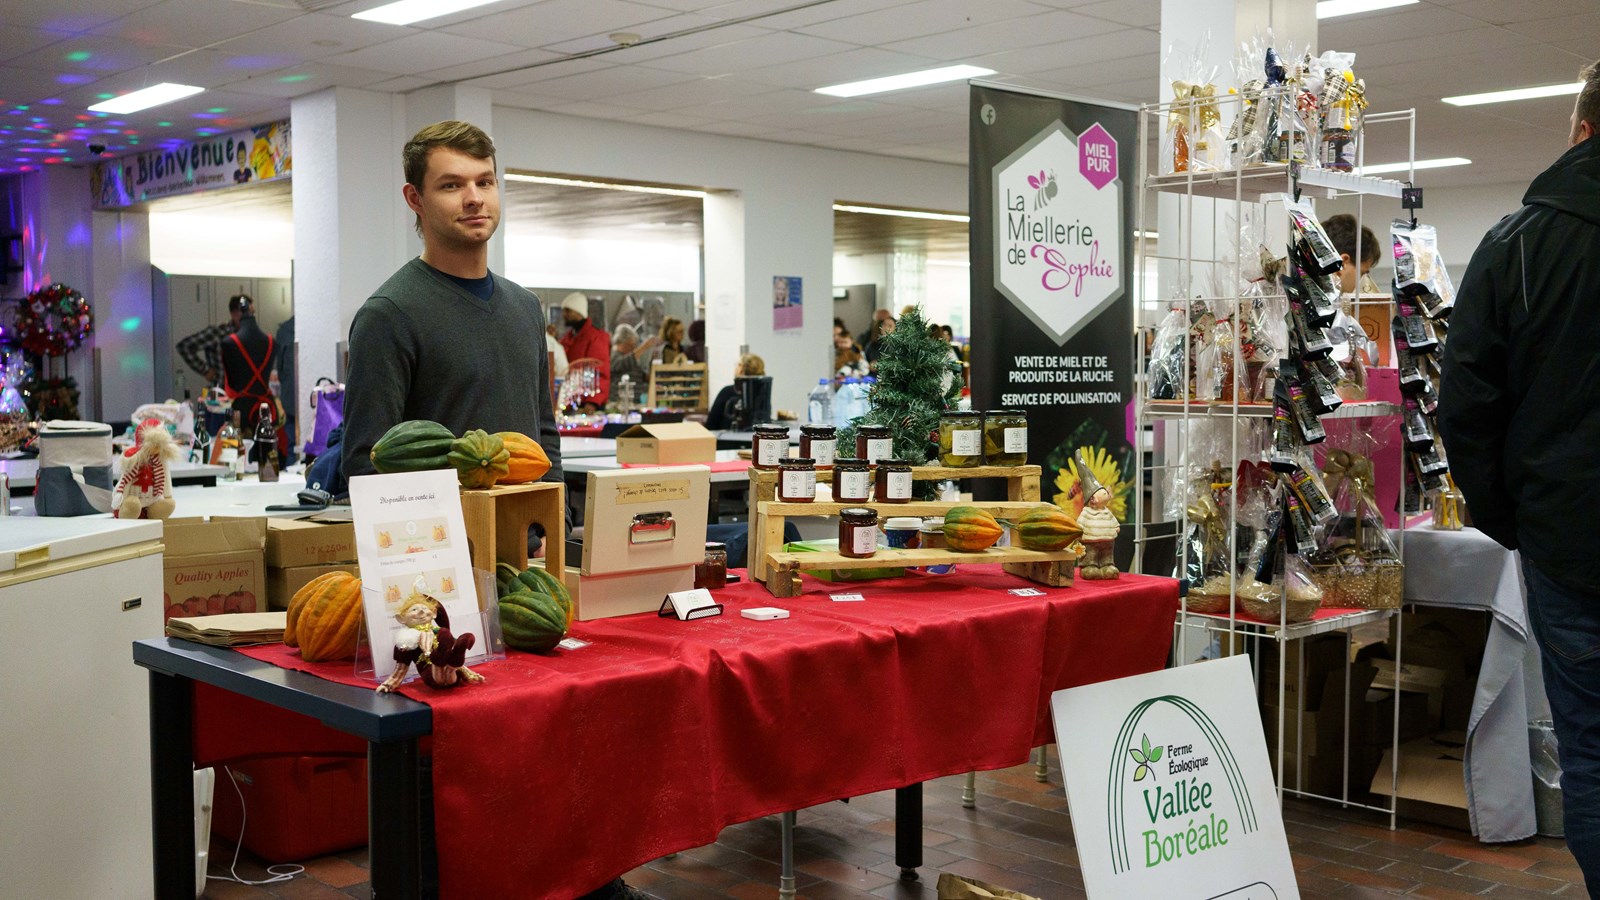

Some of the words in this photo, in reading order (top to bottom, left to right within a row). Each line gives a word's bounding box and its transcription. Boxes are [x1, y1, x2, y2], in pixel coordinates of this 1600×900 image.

[1085, 142, 1112, 159] MIEL
[136, 136, 234, 185] Bienvenue
[1087, 157, 1110, 173] PUR
[1007, 188, 1025, 212] La
[1008, 212, 1093, 246] Miellerie
[1007, 243, 1026, 265] de
[1030, 240, 1113, 298] Sophie
[1014, 356, 1044, 368] VENTE
[1045, 356, 1058, 368] DE
[1060, 356, 1081, 368] MIEL
[1082, 356, 1093, 368] ET
[1095, 356, 1108, 368] DE
[1009, 371, 1054, 382] PRODUITS
[1055, 371, 1068, 382] DE
[1069, 371, 1081, 382] LA
[1082, 370, 1114, 382] RUCHE
[1001, 393, 1038, 406] SERVICE
[1039, 393, 1052, 405] DE
[1053, 392, 1121, 405] POLLINISATION
[380, 494, 407, 505] Disponible
[174, 571, 213, 585] Quality
[215, 567, 249, 583] Apples
[1167, 743, 1193, 758] Ferme
[1168, 755, 1209, 775] Écologique
[1143, 776, 1213, 824] Vallée
[1142, 812, 1229, 868] Boréale
